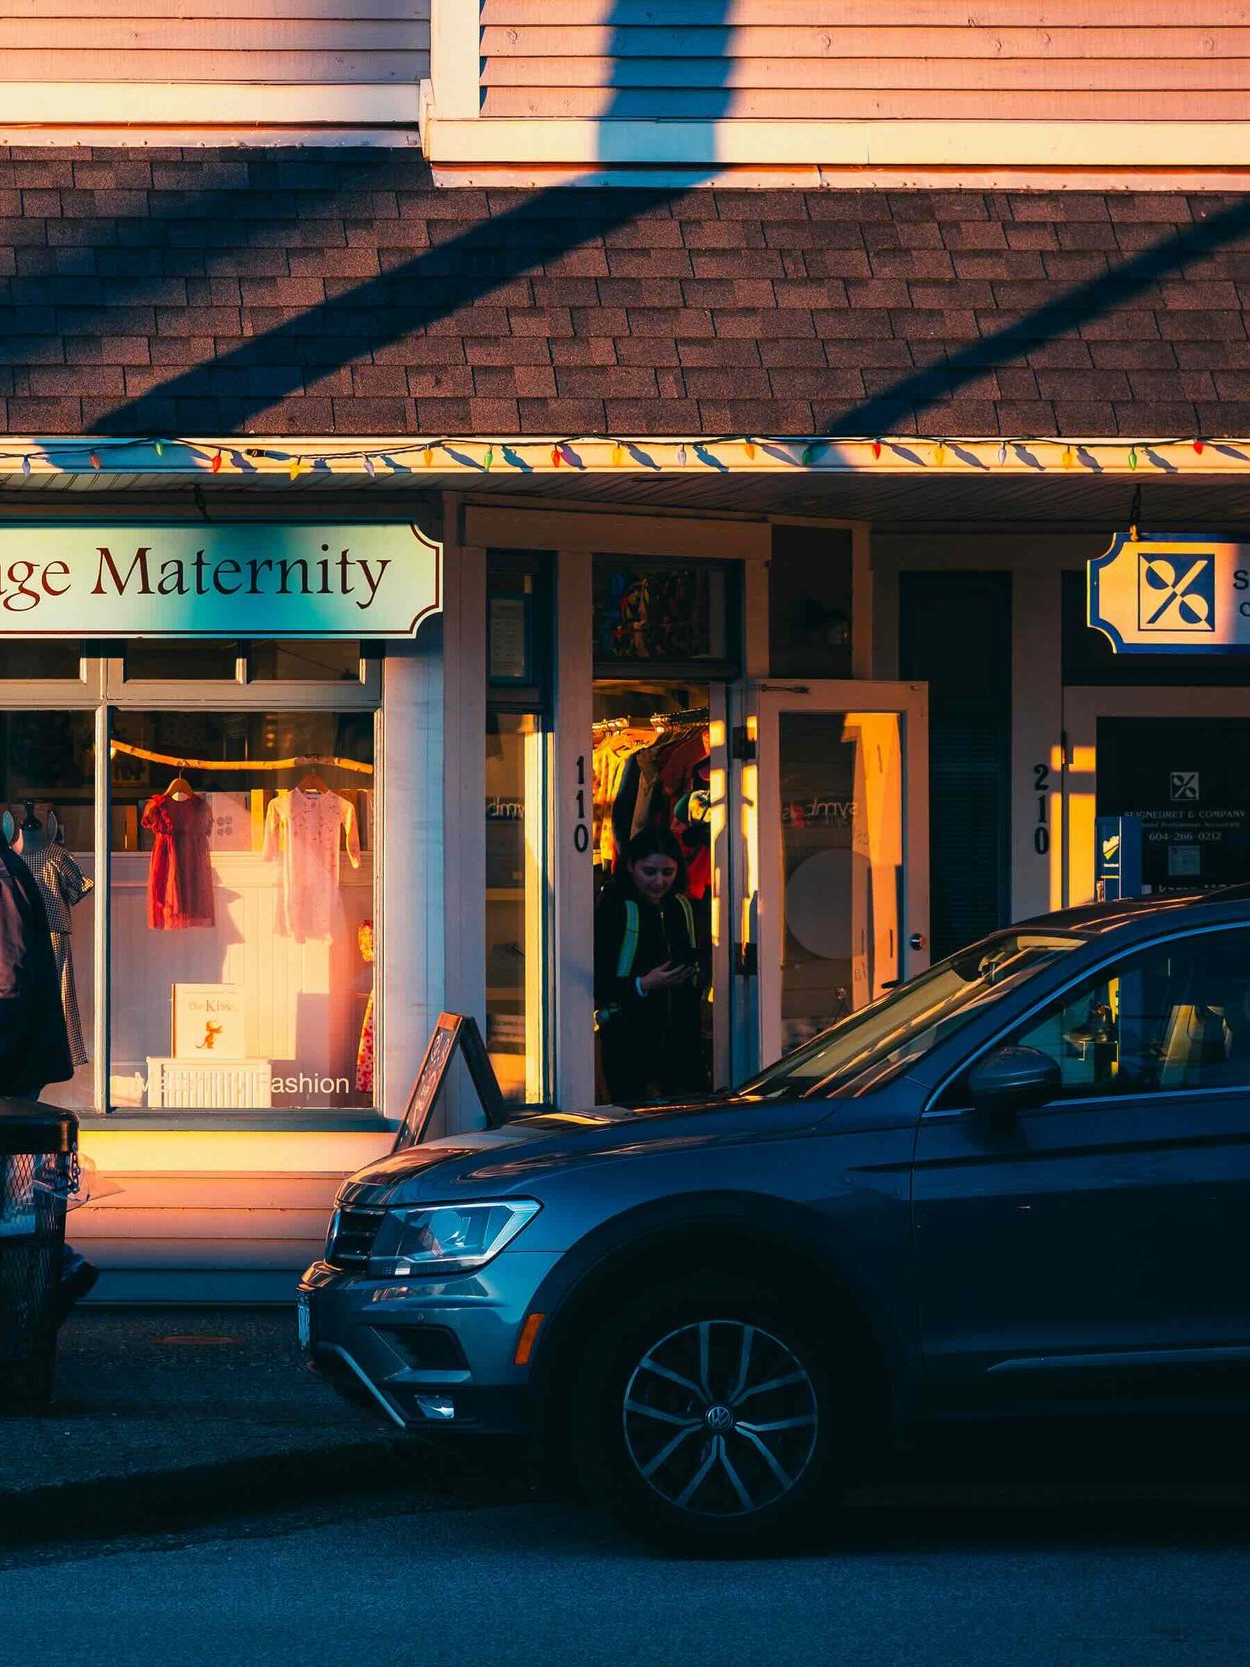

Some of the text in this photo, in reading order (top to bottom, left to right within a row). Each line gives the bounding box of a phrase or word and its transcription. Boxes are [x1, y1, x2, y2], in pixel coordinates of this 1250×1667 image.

[90, 544, 391, 610] Maternity
[1034, 763, 1050, 855] 210
[1198, 810, 1246, 818] COMPANY
[261, 1072, 349, 1093] ashion
